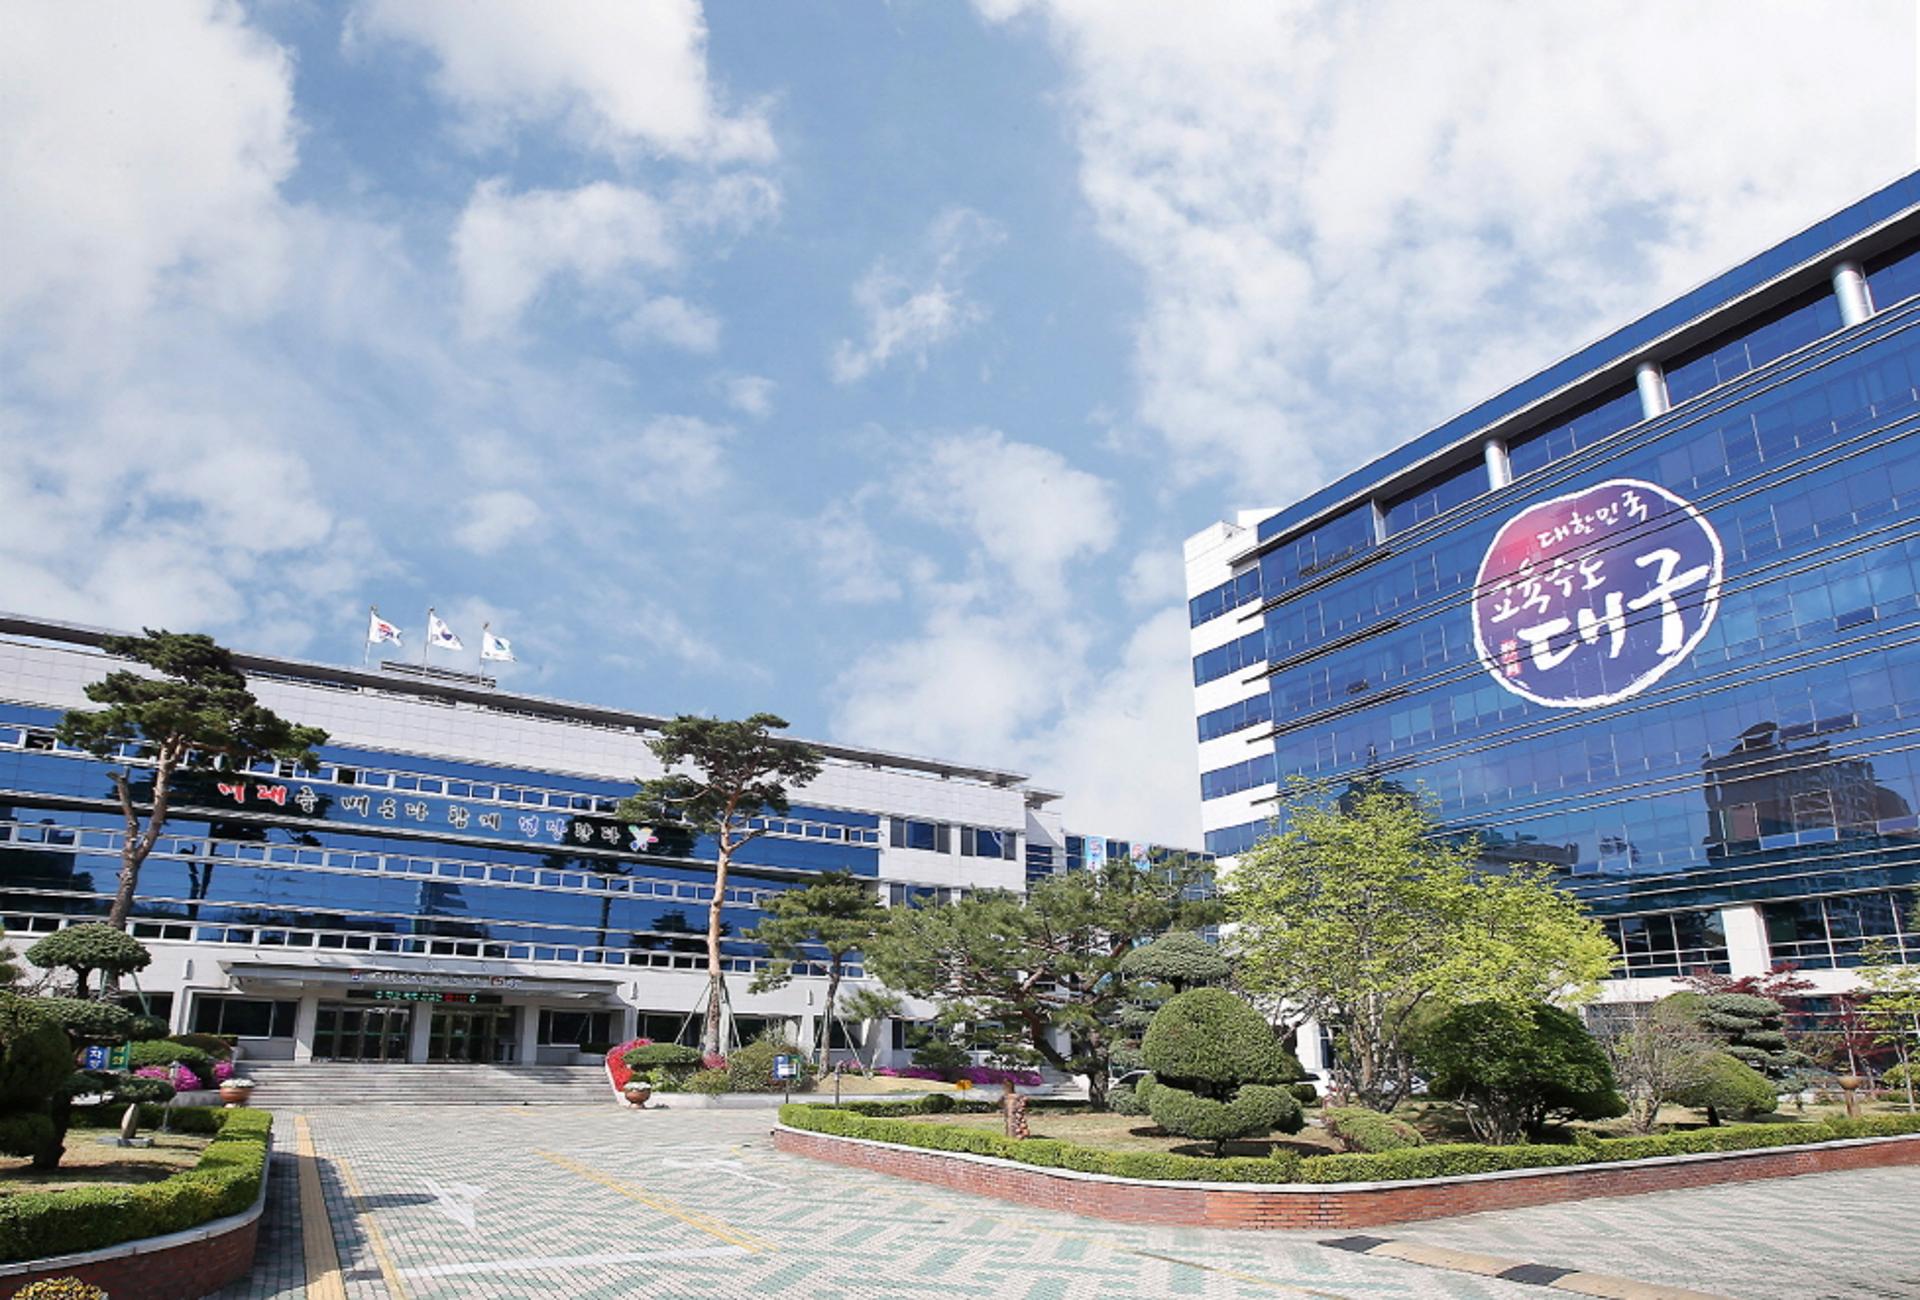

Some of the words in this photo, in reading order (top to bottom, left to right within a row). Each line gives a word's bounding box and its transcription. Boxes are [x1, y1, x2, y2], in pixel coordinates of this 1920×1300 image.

[1536, 490, 1648, 549] 대한민국
[1490, 550, 1607, 624] 교육수도
[1516, 548, 1711, 672] 대구
[447, 804, 501, 832] 함께
